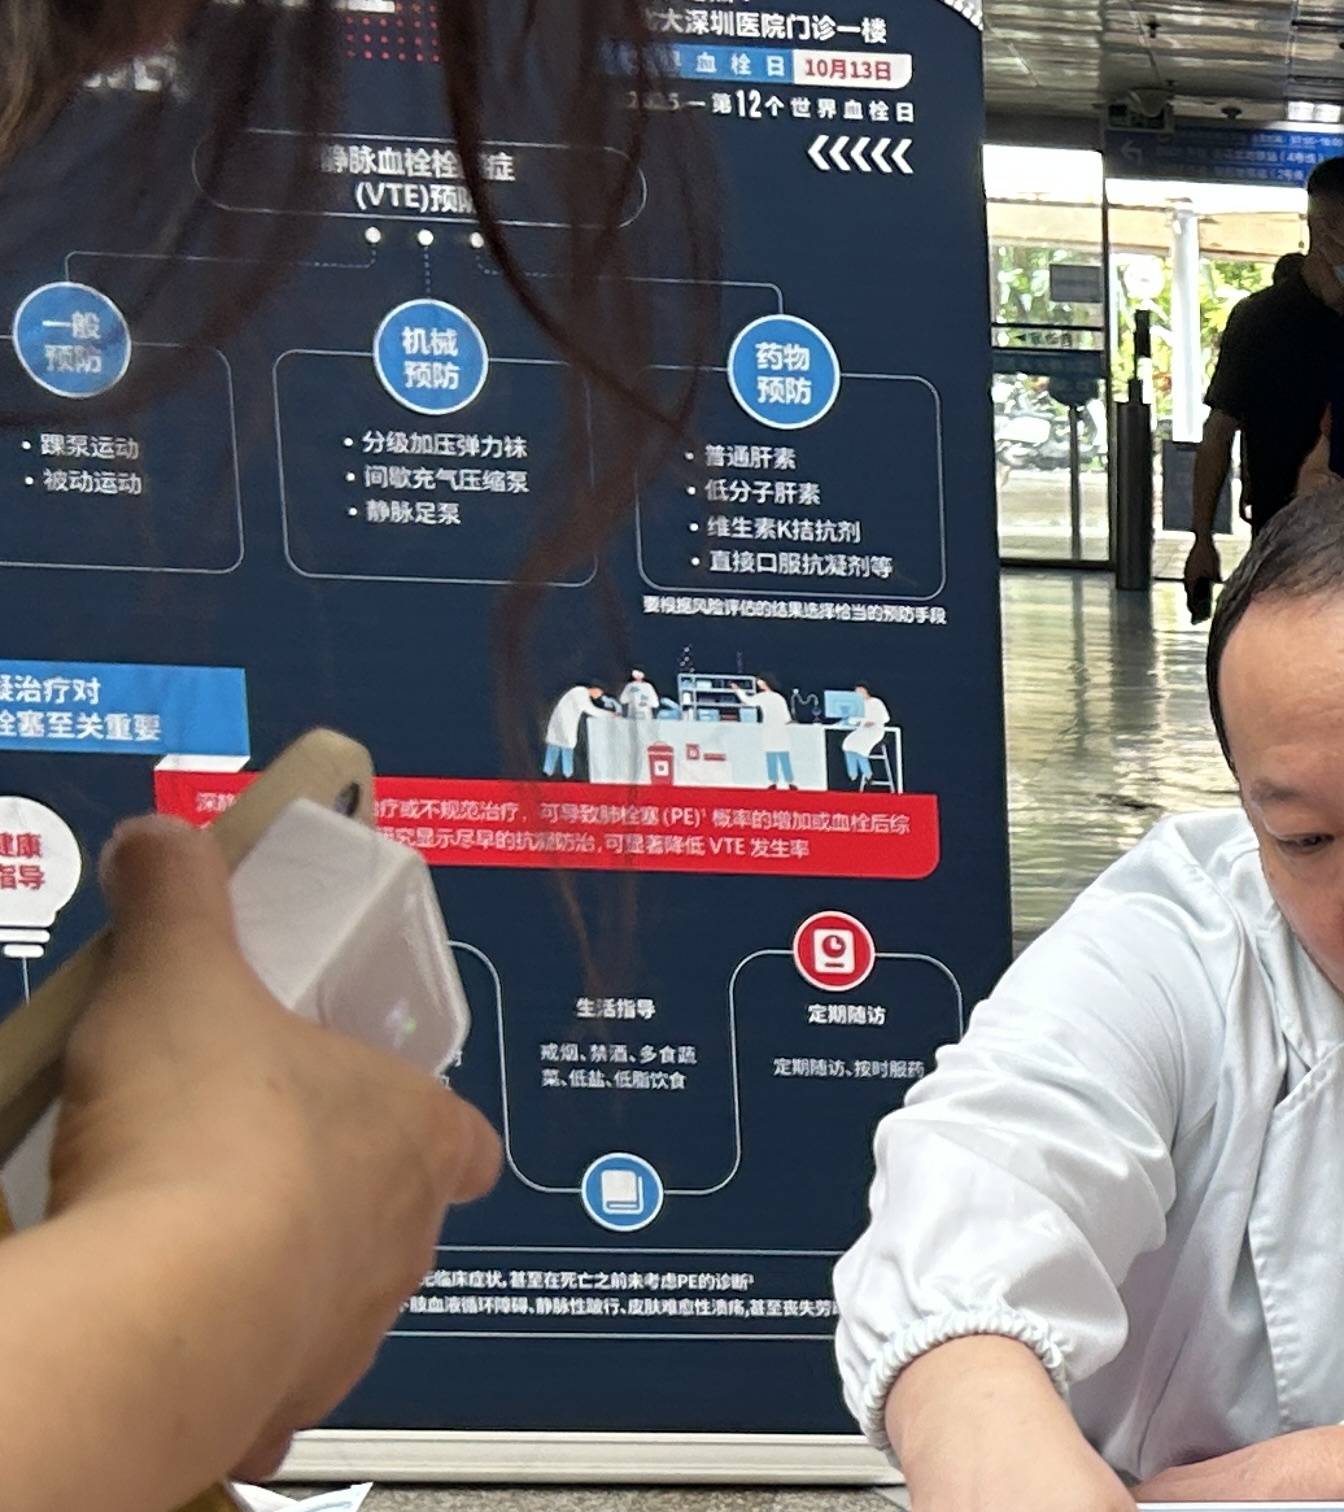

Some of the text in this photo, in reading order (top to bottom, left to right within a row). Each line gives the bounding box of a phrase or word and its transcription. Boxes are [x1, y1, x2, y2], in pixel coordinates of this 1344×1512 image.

[804, 58, 892, 82] 10月13日
[322, 145, 516, 181] 静脉血栓栓症
[42, 311, 100, 339] 一般
[402, 326, 459, 356] 机械
[45, 345, 102, 374] 预防
[756, 342, 811, 371] 药物
[403, 361, 460, 389] 预防
[757, 376, 812, 404] 预防
[362, 430, 528, 459] 分级加压弹力袜
[704, 444, 797, 470] 普通肝素
[43, 468, 143, 495] 被动运动
[364, 465, 529, 494] 间歇充气压缩泵
[704, 478, 821, 505] 低分子肝素
[366, 499, 462, 525] 静脉足泵
[706, 515, 862, 544] 维生素K拮抗剂
[709, 549, 893, 579] 直接口服抗凝剂等
[710, 838, 745, 857] VTE
[576, 998, 656, 1021] 生活指导
[808, 1004, 887, 1027] 定期随访
